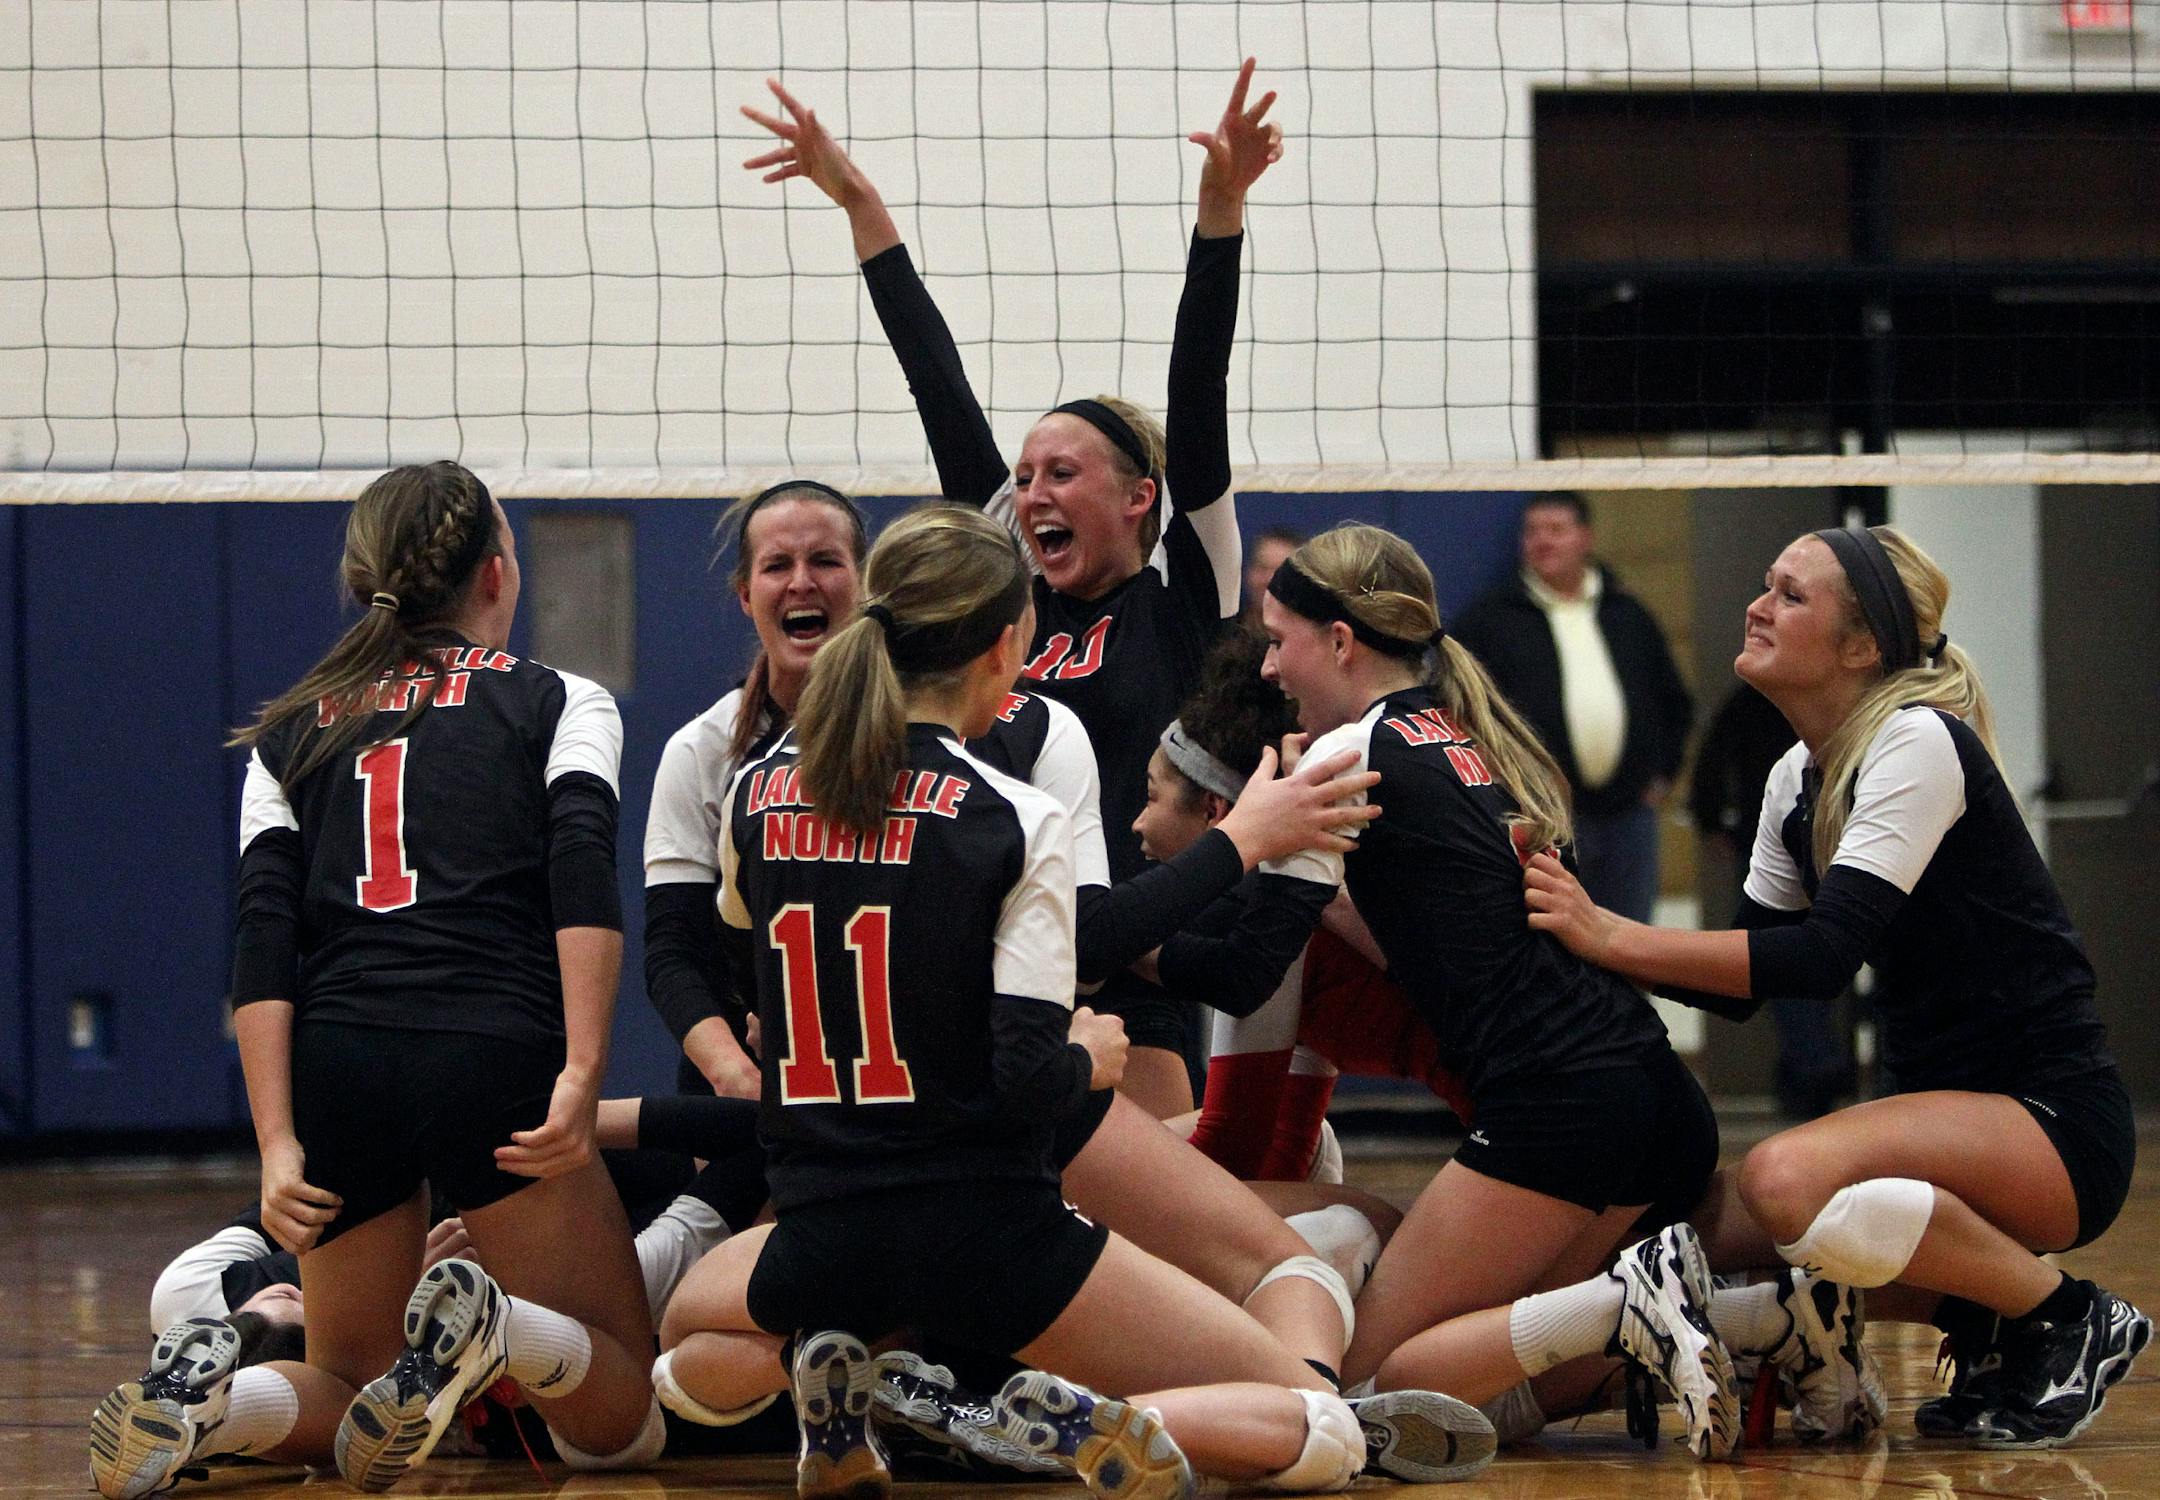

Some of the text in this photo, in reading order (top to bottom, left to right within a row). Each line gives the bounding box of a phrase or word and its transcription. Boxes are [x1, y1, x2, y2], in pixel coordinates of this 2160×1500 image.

[355, 737, 418, 913] 1
[763, 812, 917, 865] NORTH
[768, 904, 916, 1106] 11
